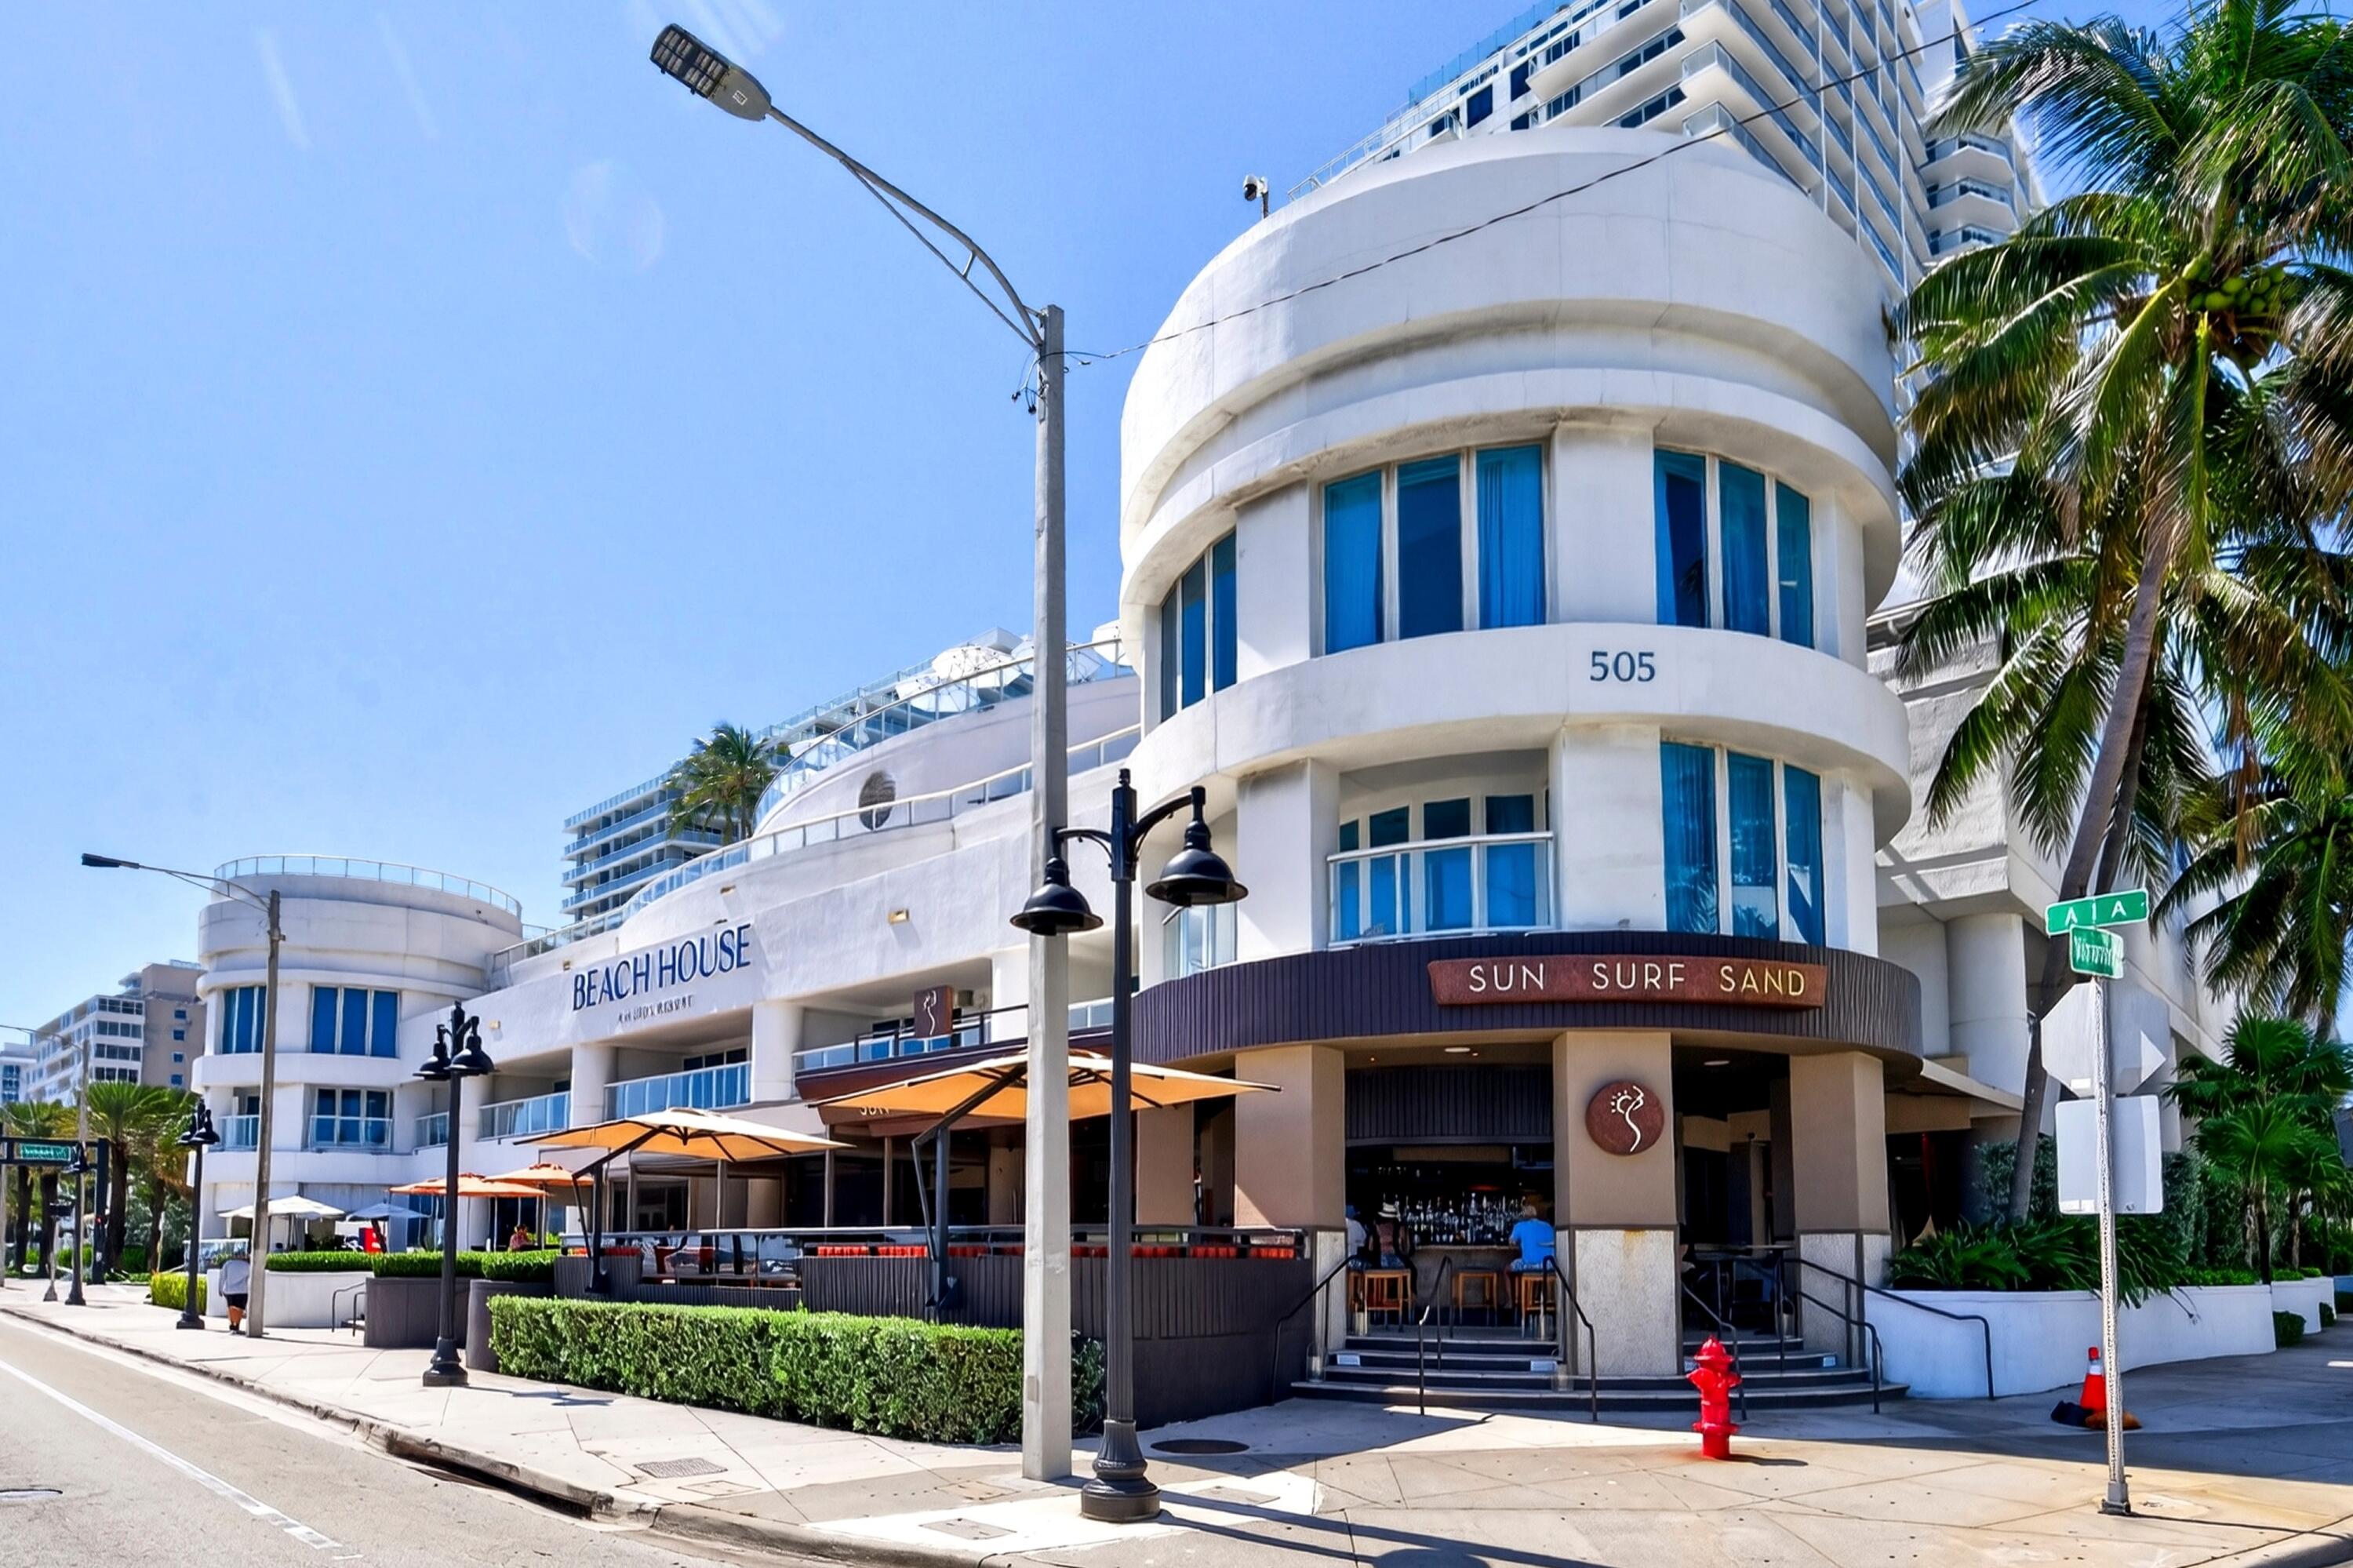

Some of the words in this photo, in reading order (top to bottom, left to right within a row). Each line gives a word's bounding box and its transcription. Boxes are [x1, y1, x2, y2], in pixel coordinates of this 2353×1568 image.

[1589, 650, 1657, 682] 505
[573, 952, 650, 1011] BEACH
[658, 923, 751, 988] HOUSE
[1468, 962, 1544, 993] SUN
[1591, 962, 1686, 991] SURF
[1719, 965, 1805, 997] SAND
